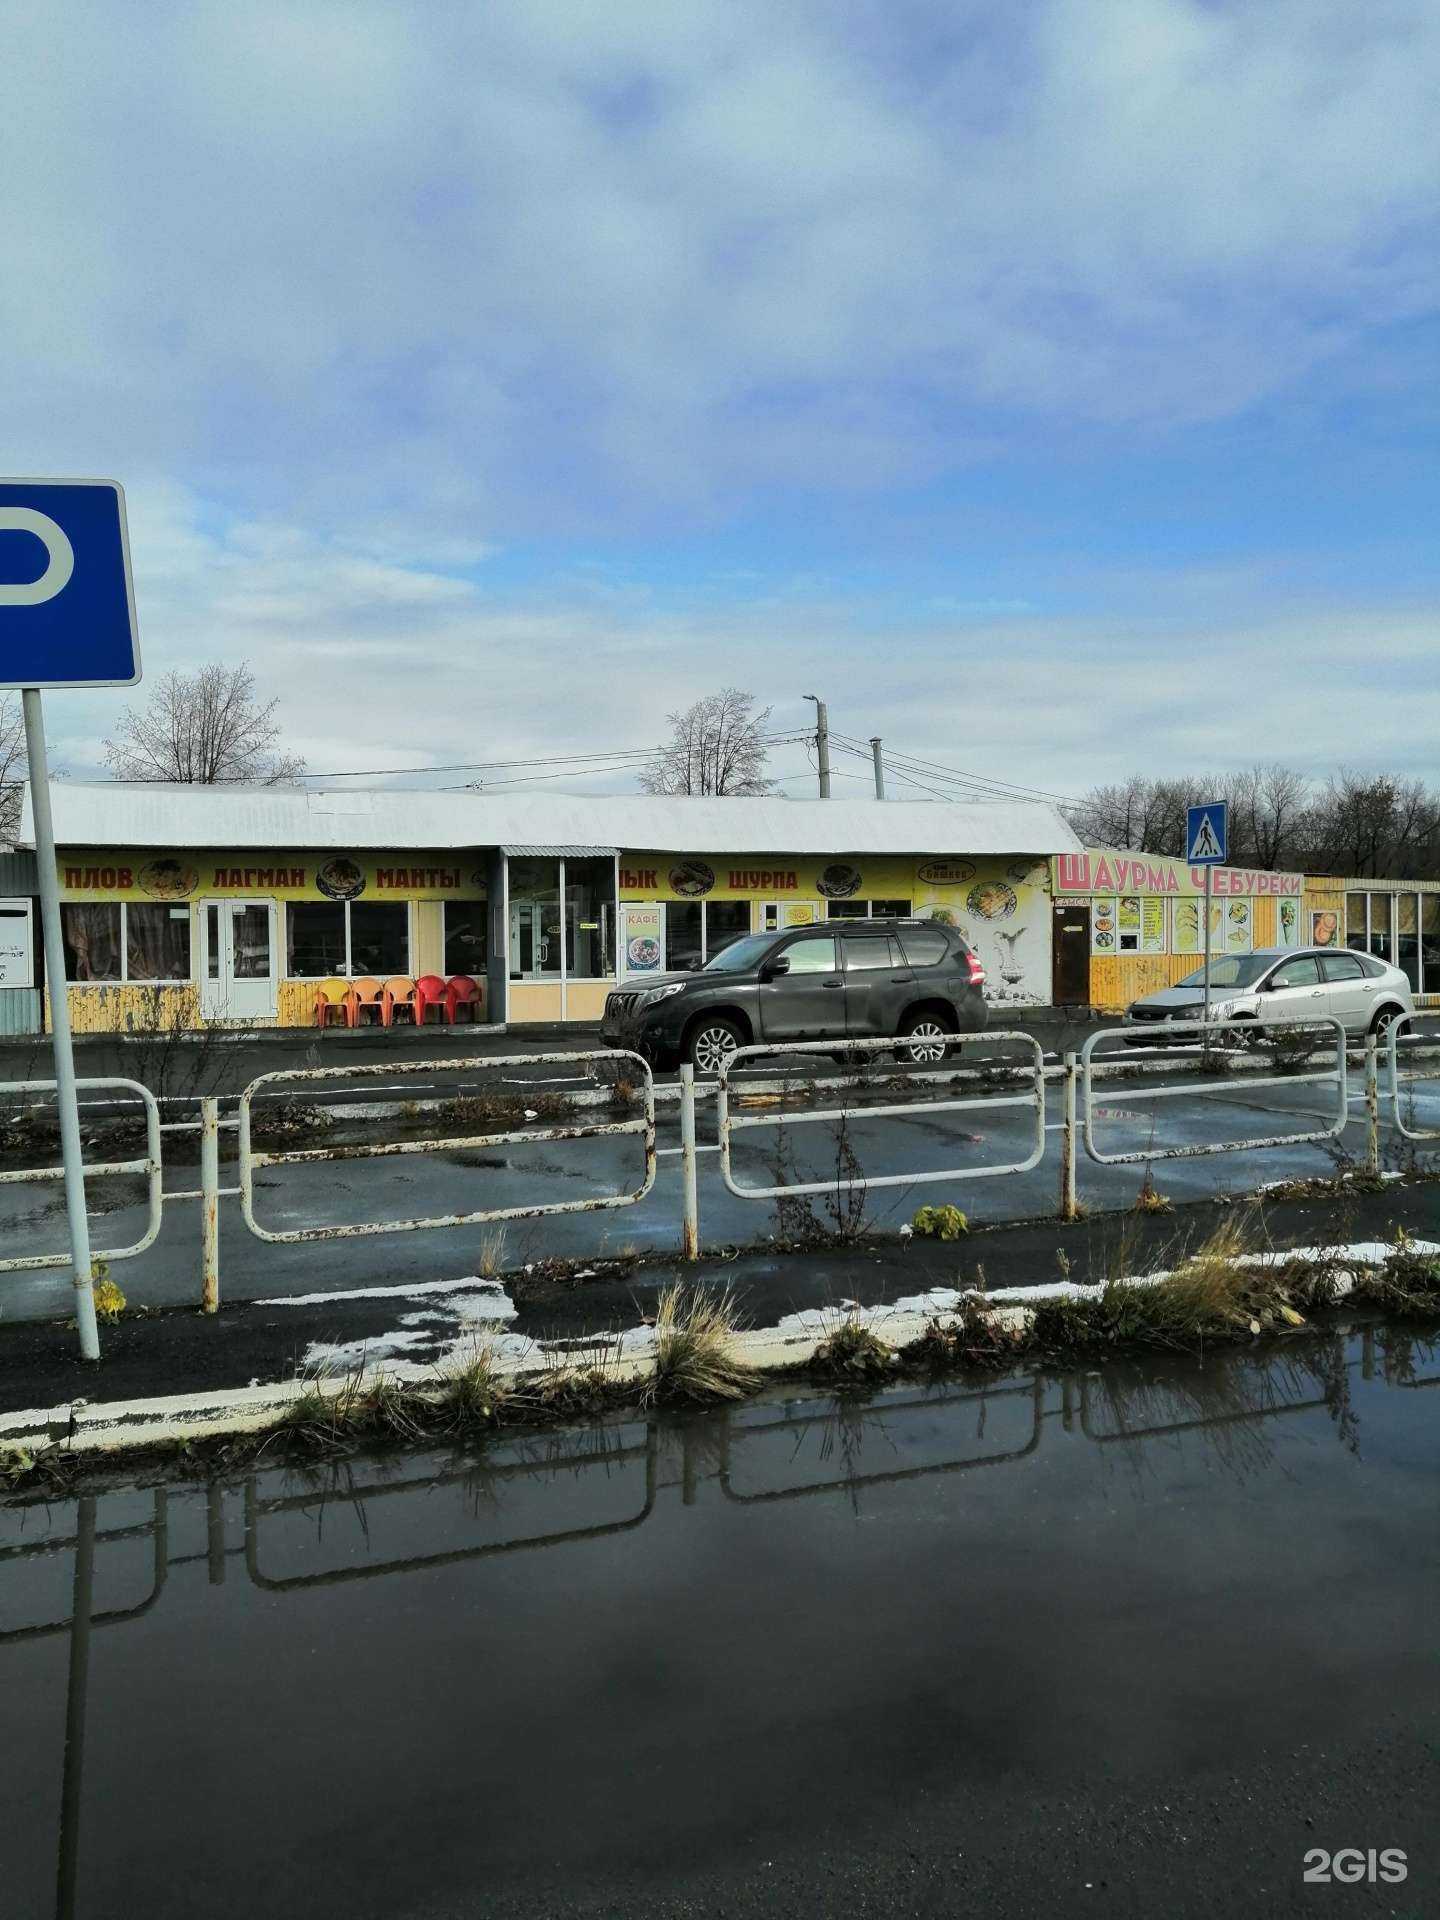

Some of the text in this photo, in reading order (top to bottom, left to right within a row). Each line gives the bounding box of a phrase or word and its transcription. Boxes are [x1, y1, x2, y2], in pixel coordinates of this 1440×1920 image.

[64, 867, 133, 888] ПЛОВ
[213, 868, 305, 887] ЛАГМАН
[377, 868, 460, 888] МАНТЫ
[729, 870, 798, 888] ШУРПА
[1058, 854, 1300, 895] ШАУРМА ЧЕБУРЕКИ
[628, 914, 658, 925] КАФЕ
